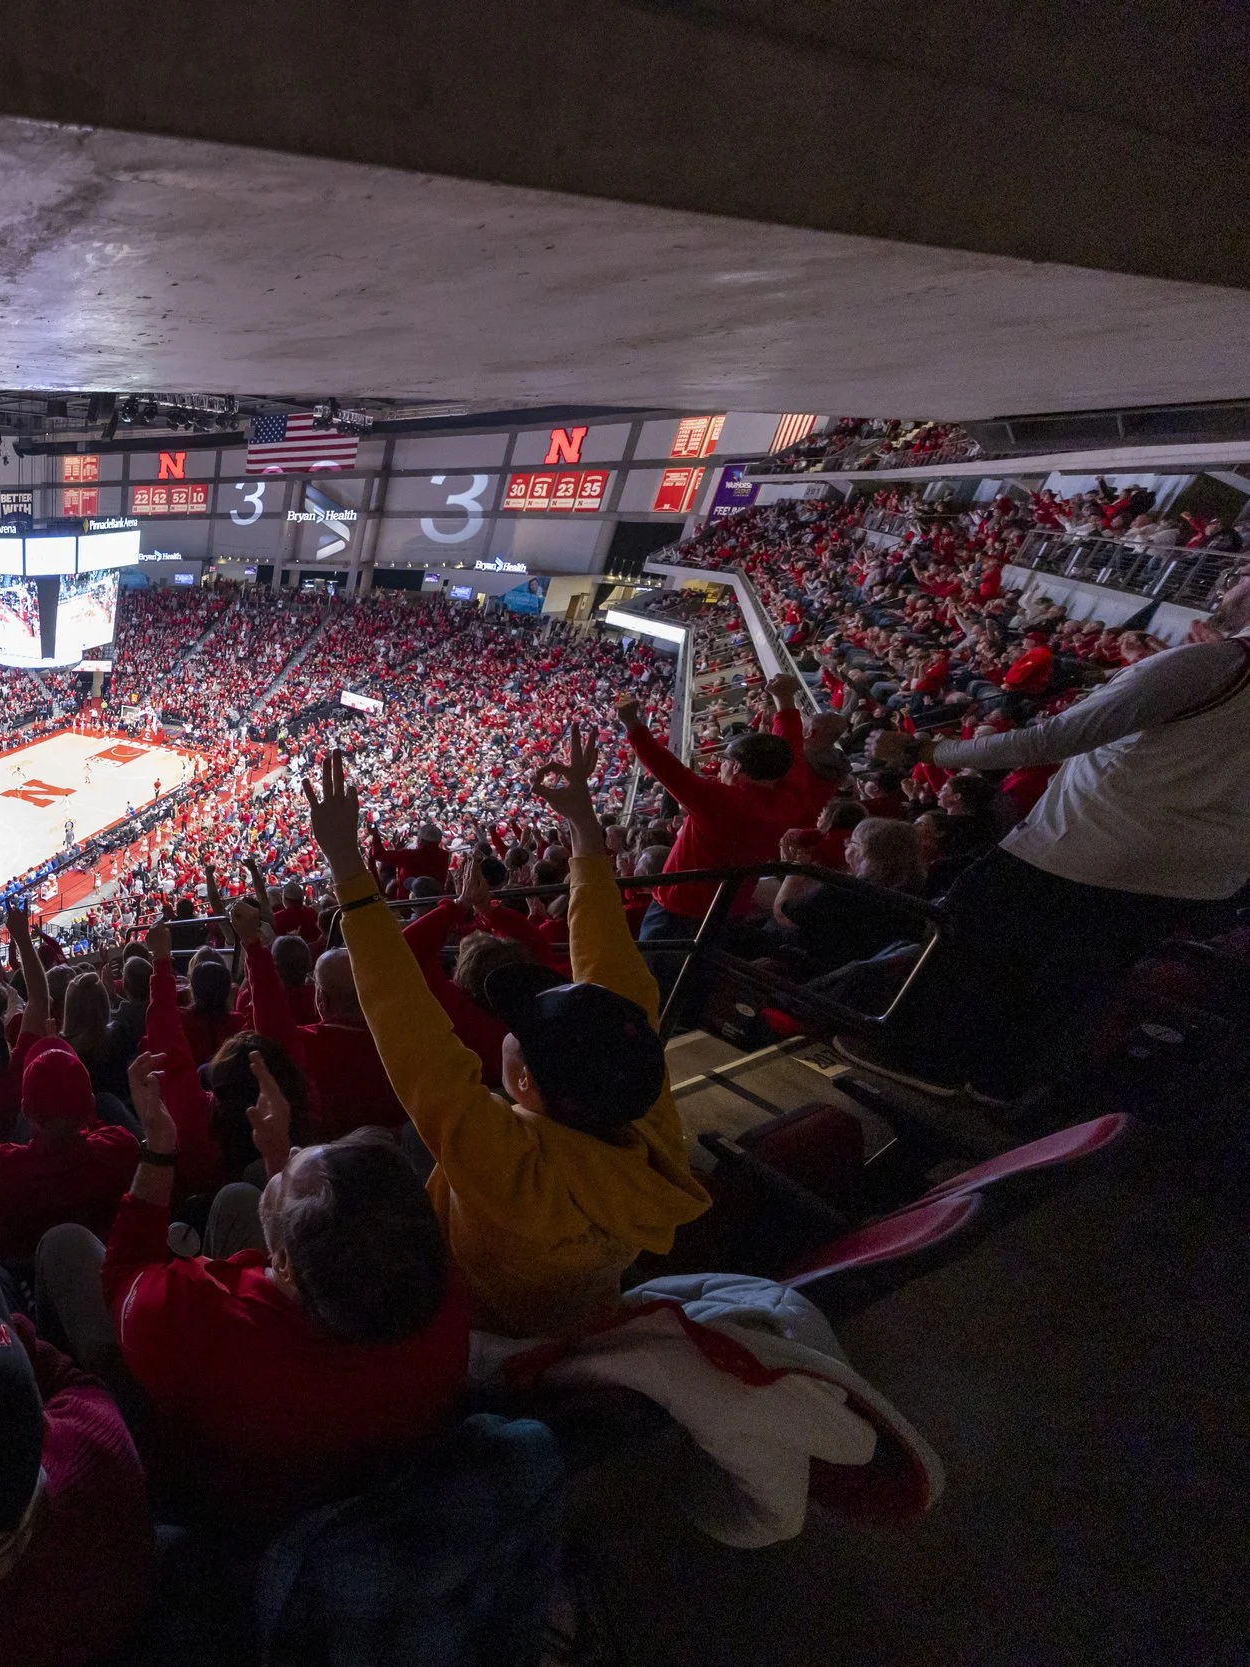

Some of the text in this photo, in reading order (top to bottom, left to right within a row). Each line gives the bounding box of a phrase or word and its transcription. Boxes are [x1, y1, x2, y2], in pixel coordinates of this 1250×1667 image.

[544, 426, 588, 465] N
[158, 452, 186, 480] N
[510, 484, 525, 497] 30
[533, 483, 548, 497] 51
[556, 483, 574, 497] 23
[581, 482, 601, 497] 35
[1, 493, 32, 503] BETTER
[134, 494, 149, 504] 22
[152, 493, 167, 504] 42
[172, 493, 187, 503] 52
[192, 492, 204, 503] 10
[2, 503, 31, 516] WITH
[287, 509, 357, 523] Bryan Health
[162, 552, 182, 560] Health
[474, 560, 527, 573] Bryan Health
